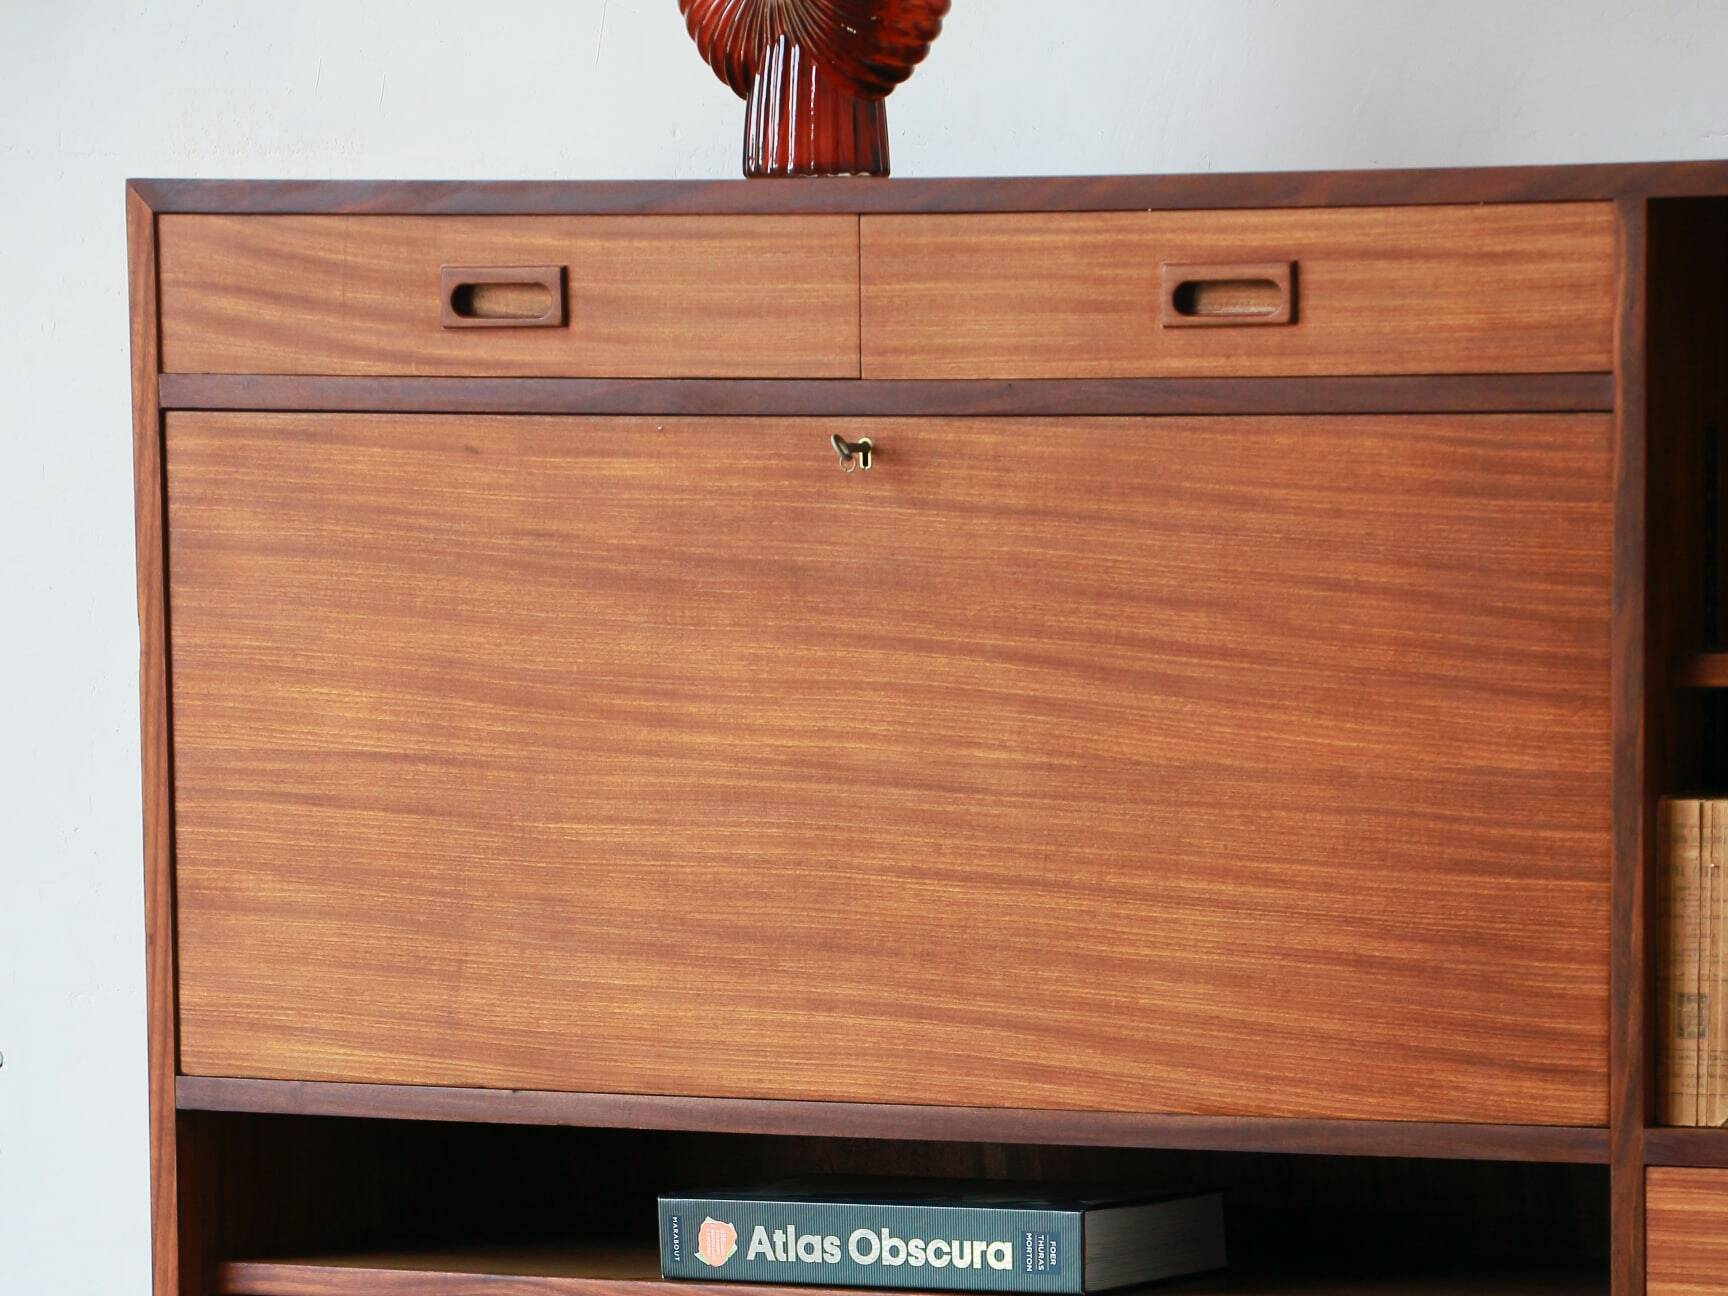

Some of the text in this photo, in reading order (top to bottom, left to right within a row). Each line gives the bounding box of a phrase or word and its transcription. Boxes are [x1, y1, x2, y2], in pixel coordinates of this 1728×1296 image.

[672, 1216, 681, 1262] MARABOUT
[747, 1224, 841, 1265] Atlas
[848, 1227, 1014, 1271] Obscura
[1049, 1241, 1057, 1265] FOER
